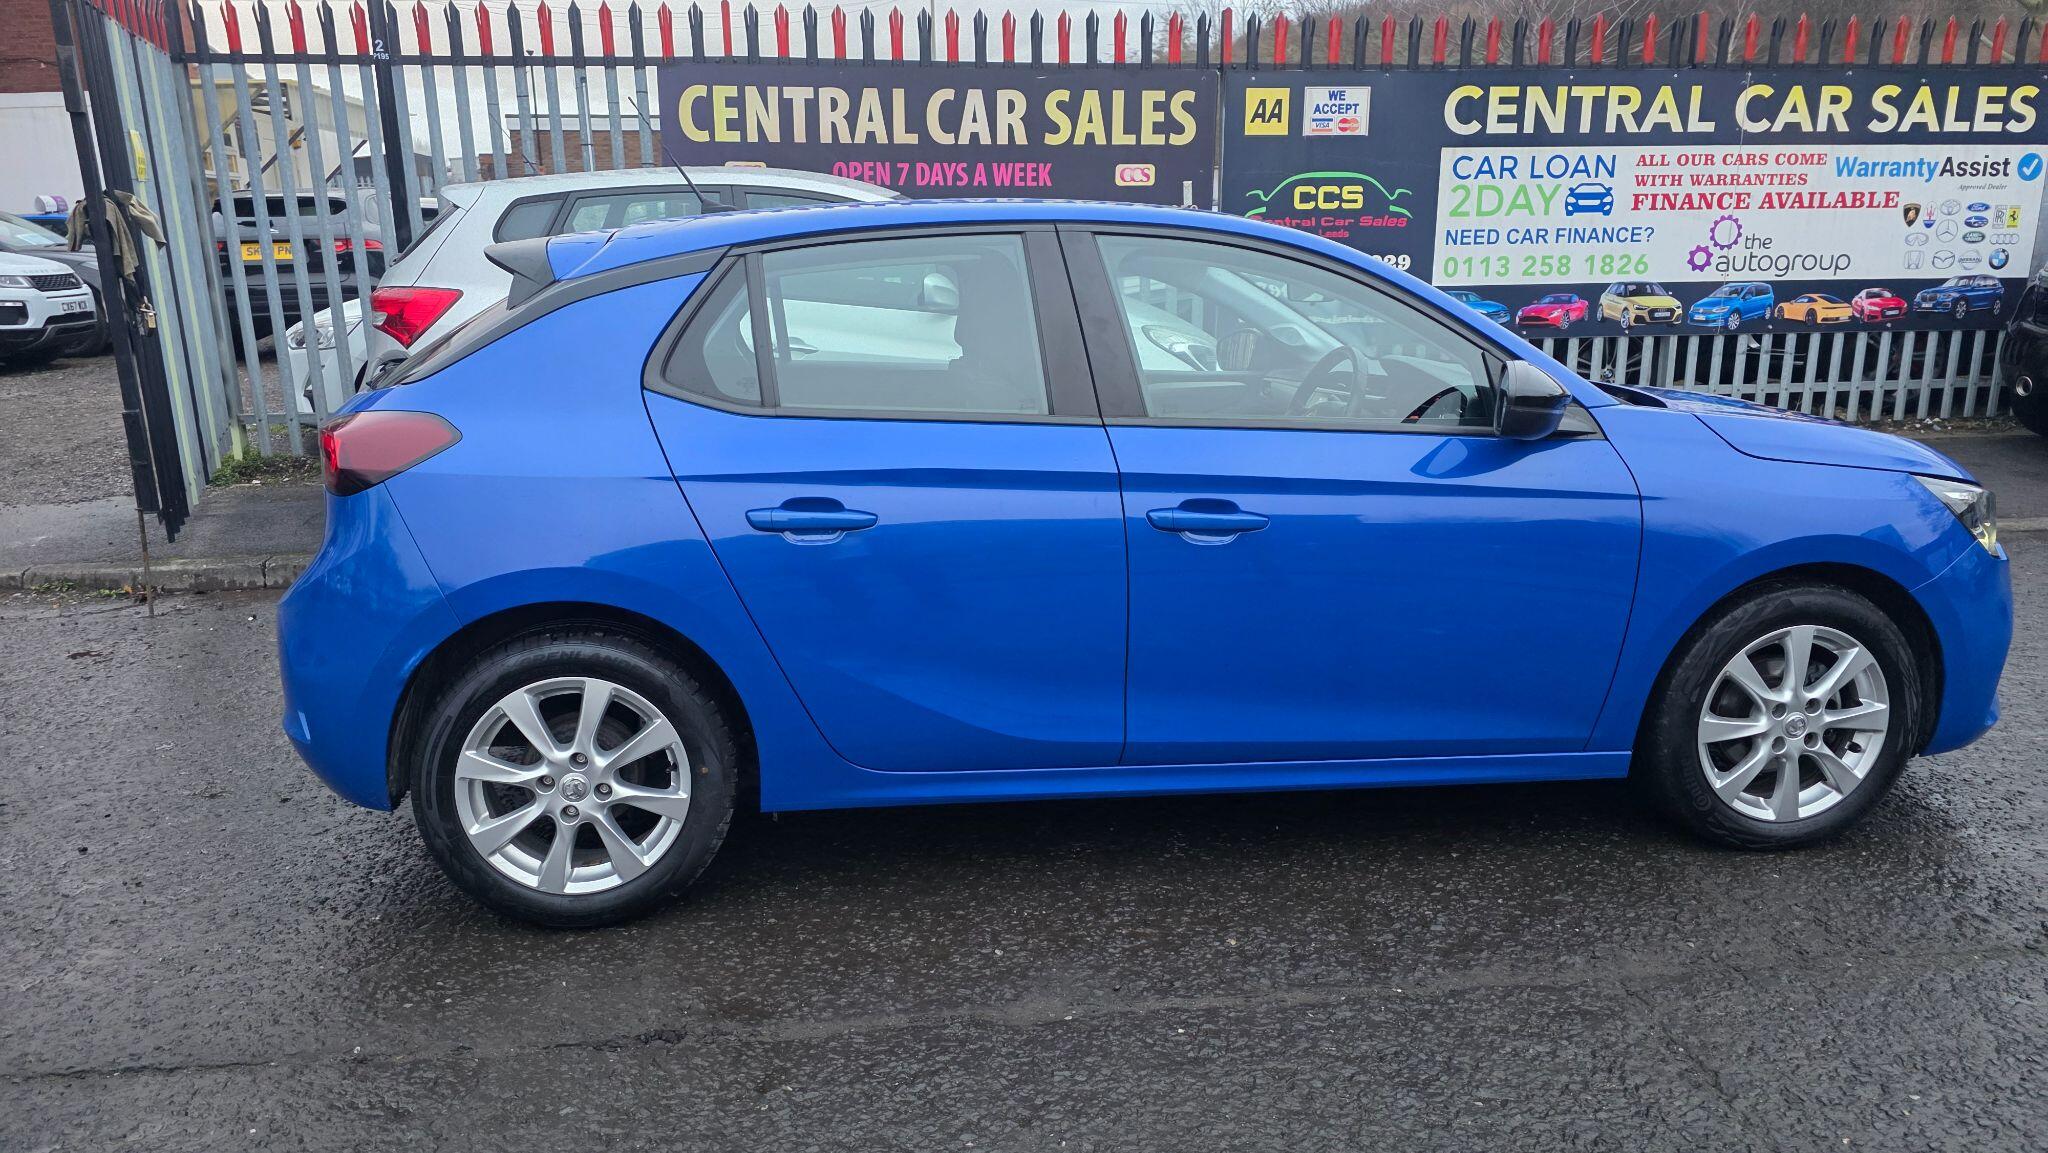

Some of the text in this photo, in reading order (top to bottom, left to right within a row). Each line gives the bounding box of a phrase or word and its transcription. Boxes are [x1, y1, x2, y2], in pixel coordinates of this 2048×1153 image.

[374, 39, 384, 51] 2
[1328, 90, 1346, 101] WE
[678, 84, 1197, 146] CENTRAL CAR SALES
[1250, 98, 1283, 124] AA
[1313, 103, 1360, 115] ACCEPT
[1444, 84, 2041, 136] CENTRAL CAR SALES
[1452, 154, 1617, 180] CAR LOAN
[1636, 153, 1828, 167] ALL OUR CARS COME
[832, 162, 1053, 187] OPEN 7 DAYS A WEEK
[1119, 167, 1151, 183] CCS
[1635, 173, 1808, 187] WITH WARRANTIES
[1959, 183, 1986, 191] Approved
[1293, 185, 1364, 210] CCS
[1449, 183, 1562, 218] 2DAY
[1631, 191, 1900, 211] FINANCE AVAILABLE
[1321, 216, 1354, 227] Car
[1359, 215, 1408, 228] Sales
[1445, 226, 1655, 246] NEED CAR FINANCE?
[1745, 233, 1773, 250] the
[1443, 254, 1649, 278] 0113 258 1826
[1715, 251, 1851, 278] autogroup
